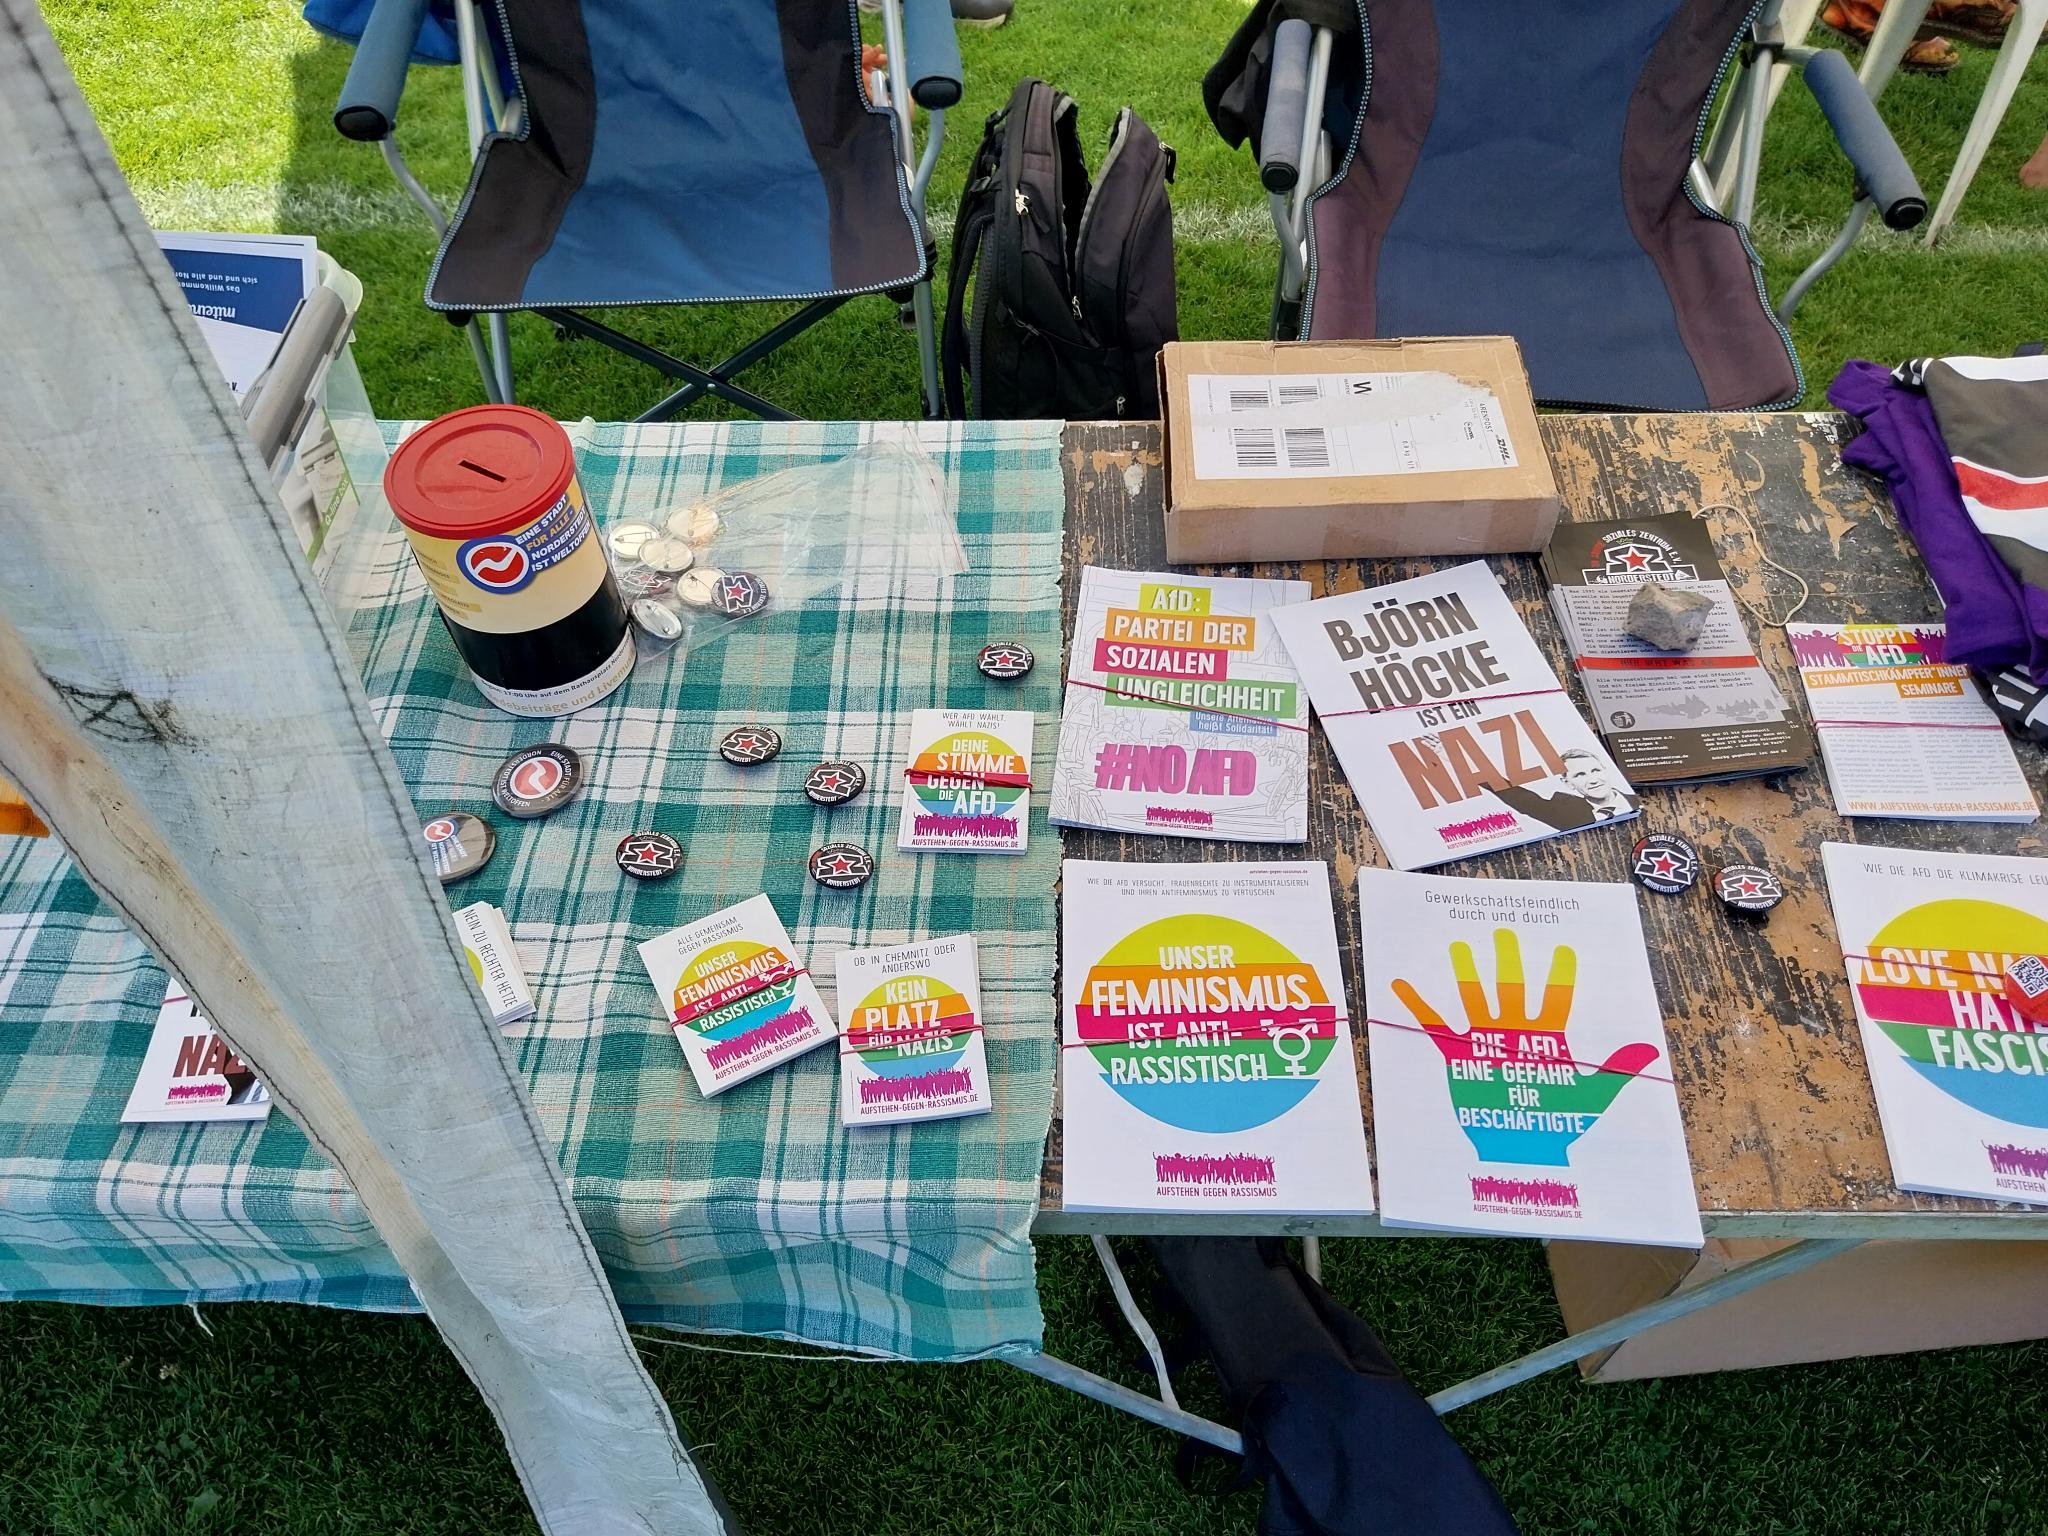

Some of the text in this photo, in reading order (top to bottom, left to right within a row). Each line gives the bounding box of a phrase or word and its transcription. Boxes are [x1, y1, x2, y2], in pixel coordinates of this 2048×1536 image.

[1478, 403, 1493, 433] ARENPOST
[1497, 438, 1510, 460] DHL
[515, 494, 567, 544] EINE STADT
[526, 514, 569, 551] FÜR ALLE
[532, 506, 586, 560] NORDERSTEDT
[1602, 529, 1636, 543] SOZIALES
[1639, 531, 1672, 551] ZENTRUM
[531, 521, 590, 571] IST WELTOFFEN
[1607, 573, 1675, 584] NORDERSTEDT
[1152, 588, 1201, 613] AfD:
[1114, 615, 1247, 646] PARTEI DER
[1323, 592, 1479, 663] BJÖRN
[1839, 628, 1909, 646] STOPPT
[1106, 645, 1216, 675] SOZIALEN
[1865, 644, 1907, 666] AFD
[554, 688, 570, 696] dem
[571, 665, 611, 691] Rathausplatz
[1349, 640, 1511, 715] HÖCKE
[1902, 683, 1958, 696] SEMINARE
[571, 691, 595, 706] und
[1115, 676, 1286, 712] UNGLEICHHEIT
[976, 721, 1000, 729] NAZIS!
[1195, 712, 1224, 722] Unsere
[1415, 698, 1482, 728] IST EIN
[1199, 721, 1272, 734] heißt Solidarität!
[952, 739, 988, 752] DEINE
[550, 750, 565, 760] EINE
[562, 759, 572, 776] STADT
[937, 752, 1015, 774] STIMME
[1387, 709, 1569, 811] NAZI
[501, 789, 530, 807] WELTOFFEN
[939, 790, 996, 815] DIE AFD
[1848, 800, 2035, 812] WWW.AUFSTEHEN-GEGEN-RASSISMUS.DE
[912, 839, 1018, 848] AUFSTEHEN-GEGEN-RASSISMUS.DE
[1103, 878, 1113, 886] DIE
[1233, 879, 1309, 887] INSTRUMENTALISIEREN
[1643, 878, 1680, 892] NORDERSTEDT
[1863, 862, 1883, 874] WIE
[1889, 865, 1905, 877] DIE
[1912, 867, 1931, 878] AFD
[1937, 869, 1954, 880] DIE
[1959, 870, 2023, 885] KLIMAKRISE
[1425, 890, 1580, 911] Gewerkschaftsfeindlich
[1737, 899, 1775, 909] NORDERSTEDT
[1449, 908, 1559, 925] durch und durch
[677, 917, 738, 946] ALLE GEMEINSAM
[679, 924, 744, 955] GEGEN RASSISMUS
[463, 909, 518, 1008] NEIN ZU RECHTER HETZE
[694, 951, 738, 977] UNSER
[853, 943, 956, 967] OB IN CHEMNITZ ODER
[881, 958, 931, 974] ANDERSWO
[1158, 945, 1236, 970] UNSER
[1862, 946, 1958, 988] LOVE
[678, 951, 780, 1006] FEMINISMUS
[885, 979, 928, 1003] KEIN
[694, 984, 754, 1013] IST ANTI-
[1091, 973, 1312, 1017] FEMINISMUS
[700, 989, 776, 1032] RASSISTISCH
[865, 1000, 941, 1033] PLATZ
[868, 1028, 954, 1057] FÜR NAZIS
[1127, 1020, 1242, 1050] IST ANTI-
[1471, 1031, 1567, 1061] DIE AFD:
[714, 1027, 821, 1081] AUFSTEHEN-GEGEN-RASSISMUS.DE
[1110, 1053, 1268, 1085] RASSISTISCH
[1451, 1059, 1576, 1086] EINE GEFAHR
[860, 1094, 979, 1115] AUFSTEHEN-GEGEN-RASSISMUS.DE
[1508, 1084, 1540, 1108] FÜR
[1459, 1107, 1585, 1134] BESCHÄFTIGTE
[1156, 1186, 1278, 1198] AUFSTEHEN GEGEN RASSISMUS
[1996, 1178, 2046, 1192] AUFSTEHEN
[1473, 1204, 1583, 1219] AUFSTEHEN-GEGEN-RASSISMUS.DE
